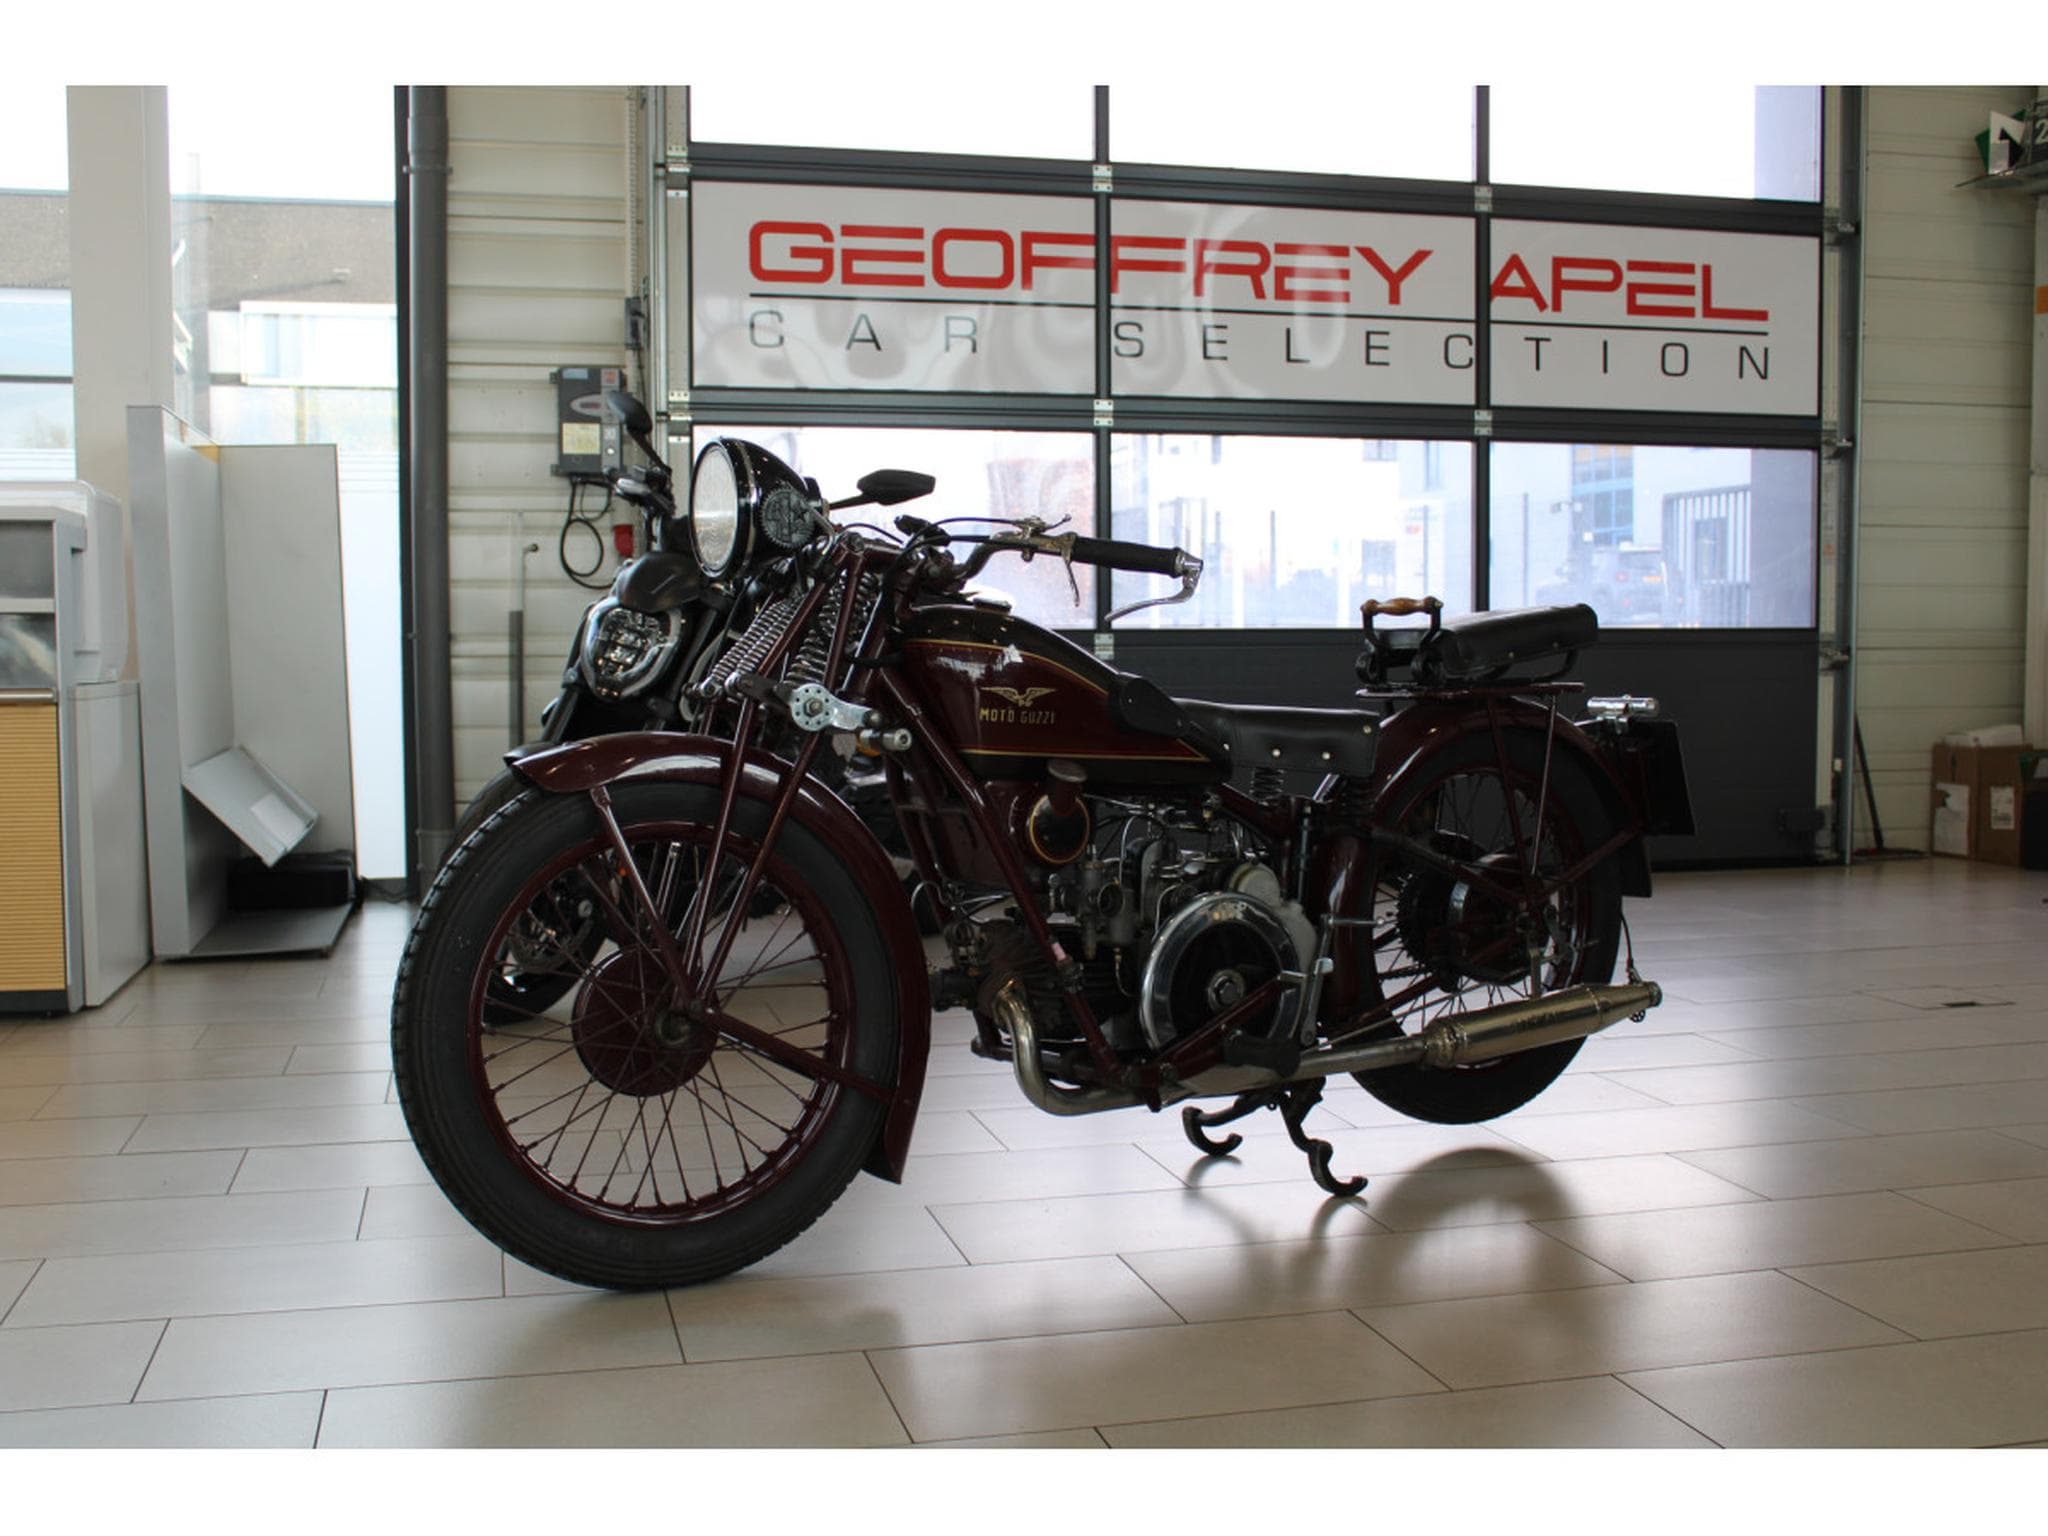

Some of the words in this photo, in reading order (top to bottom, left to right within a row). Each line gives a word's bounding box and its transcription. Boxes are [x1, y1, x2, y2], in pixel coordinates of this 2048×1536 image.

[748, 220, 1433, 305] GEOFFREY
[1490, 253, 1769, 322] APEL
[748, 310, 978, 353] CAR
[1114, 321, 1769, 380] SELECTION
[979, 708, 1015, 723] MOTO
[1020, 710, 1055, 724] GUZZI
